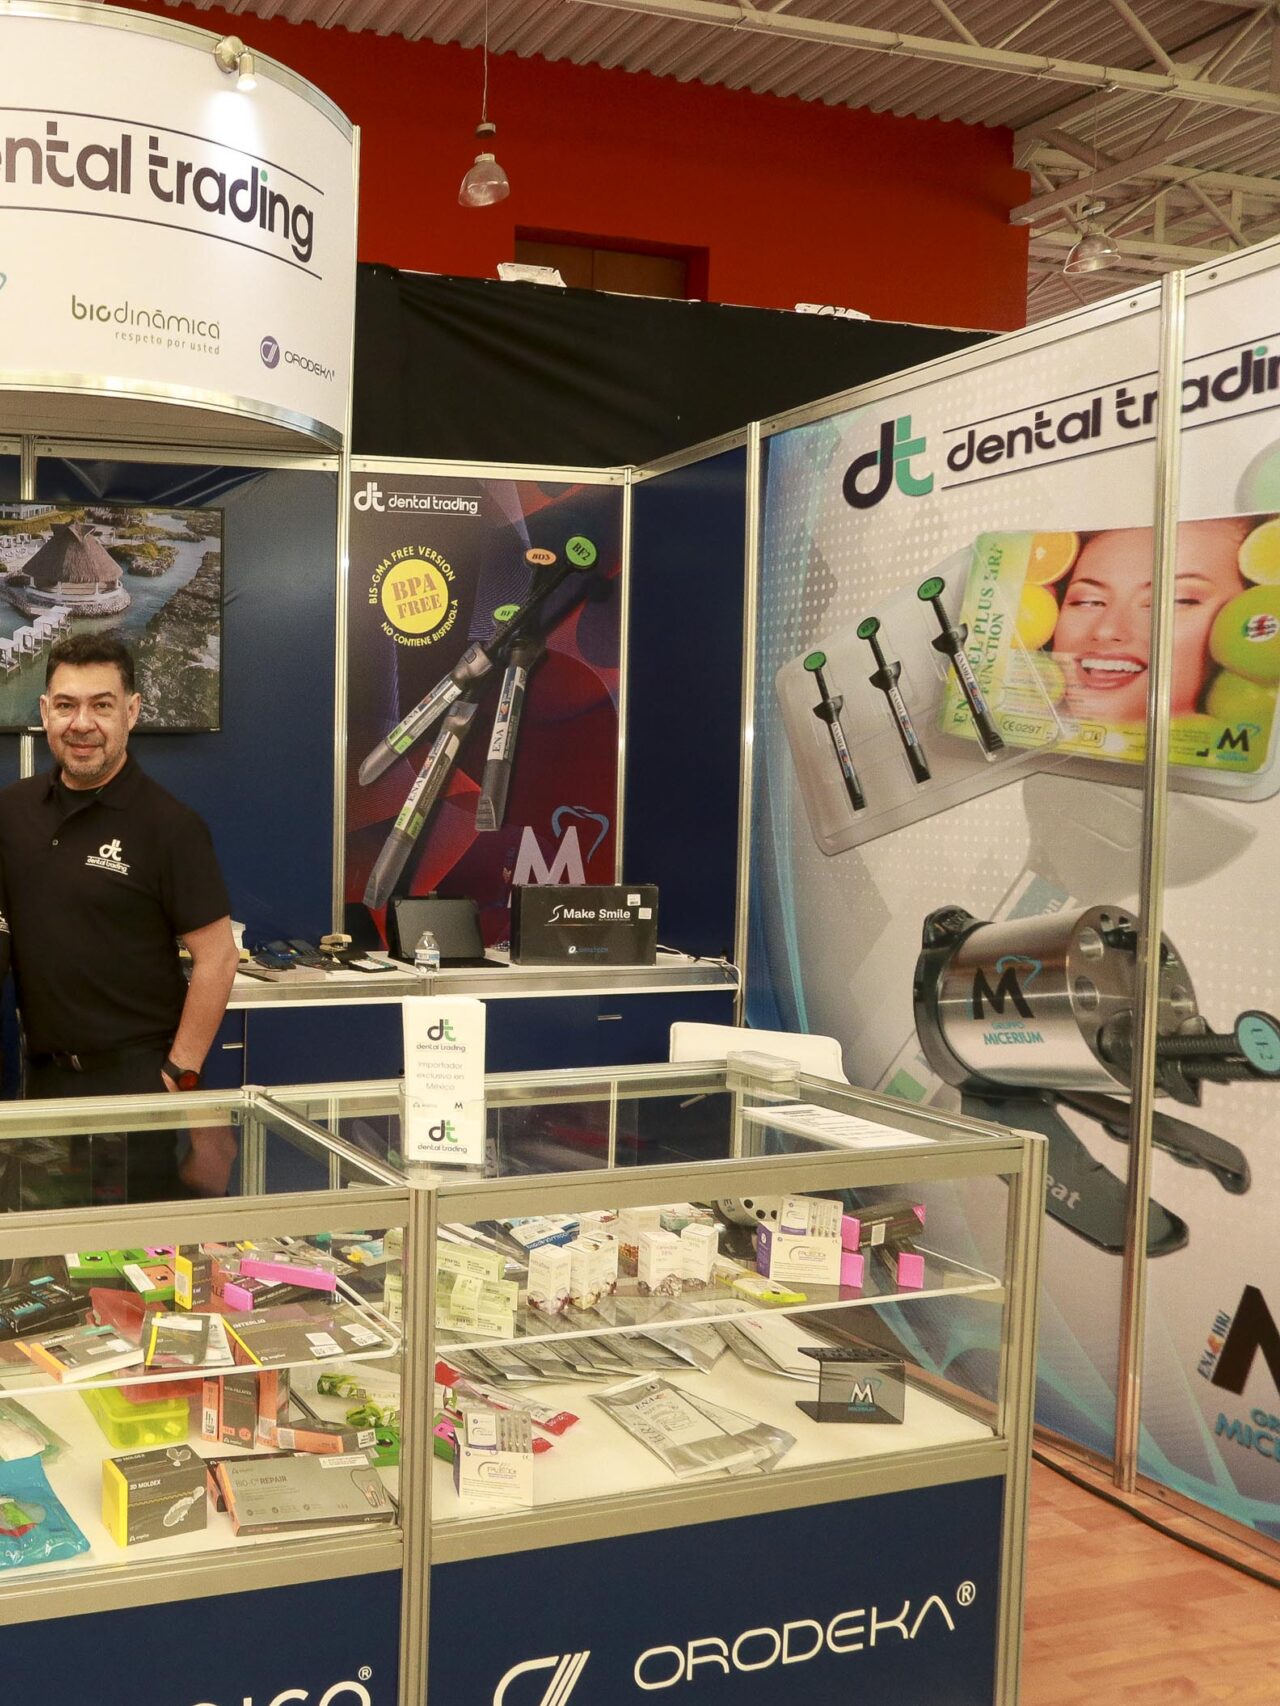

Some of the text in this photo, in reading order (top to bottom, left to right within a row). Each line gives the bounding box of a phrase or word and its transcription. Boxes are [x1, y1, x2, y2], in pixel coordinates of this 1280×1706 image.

[148, 135, 314, 263] trading
[115, 329, 220, 355] respeto por usted
[284, 350, 333, 382] ORODEKA
[946, 397, 1103, 472] dental
[388, 495, 431, 510] dental
[432, 496, 479, 514] trading
[369, 545, 456, 604] BIS-GMA FREE VERSION
[391, 572, 438, 601] BPA
[396, 593, 443, 620] FREE
[975, 587, 994, 635] PLUS
[380, 599, 459, 647] NO CONTIENE BISFENOL-A
[493, 728, 505, 752] ENA
[563, 908, 631, 919] Make Smile
[972, 967, 1035, 1021] M
[416, 1043, 466, 1053] dental trading
[983, 1031, 1045, 1045] MICERIUM
[441, 1144, 468, 1154] trading
[850, 1383, 874, 1404] M
[259, 1475, 288, 1486] REPAIR
[632, 1593, 957, 1693] ORODEKA
